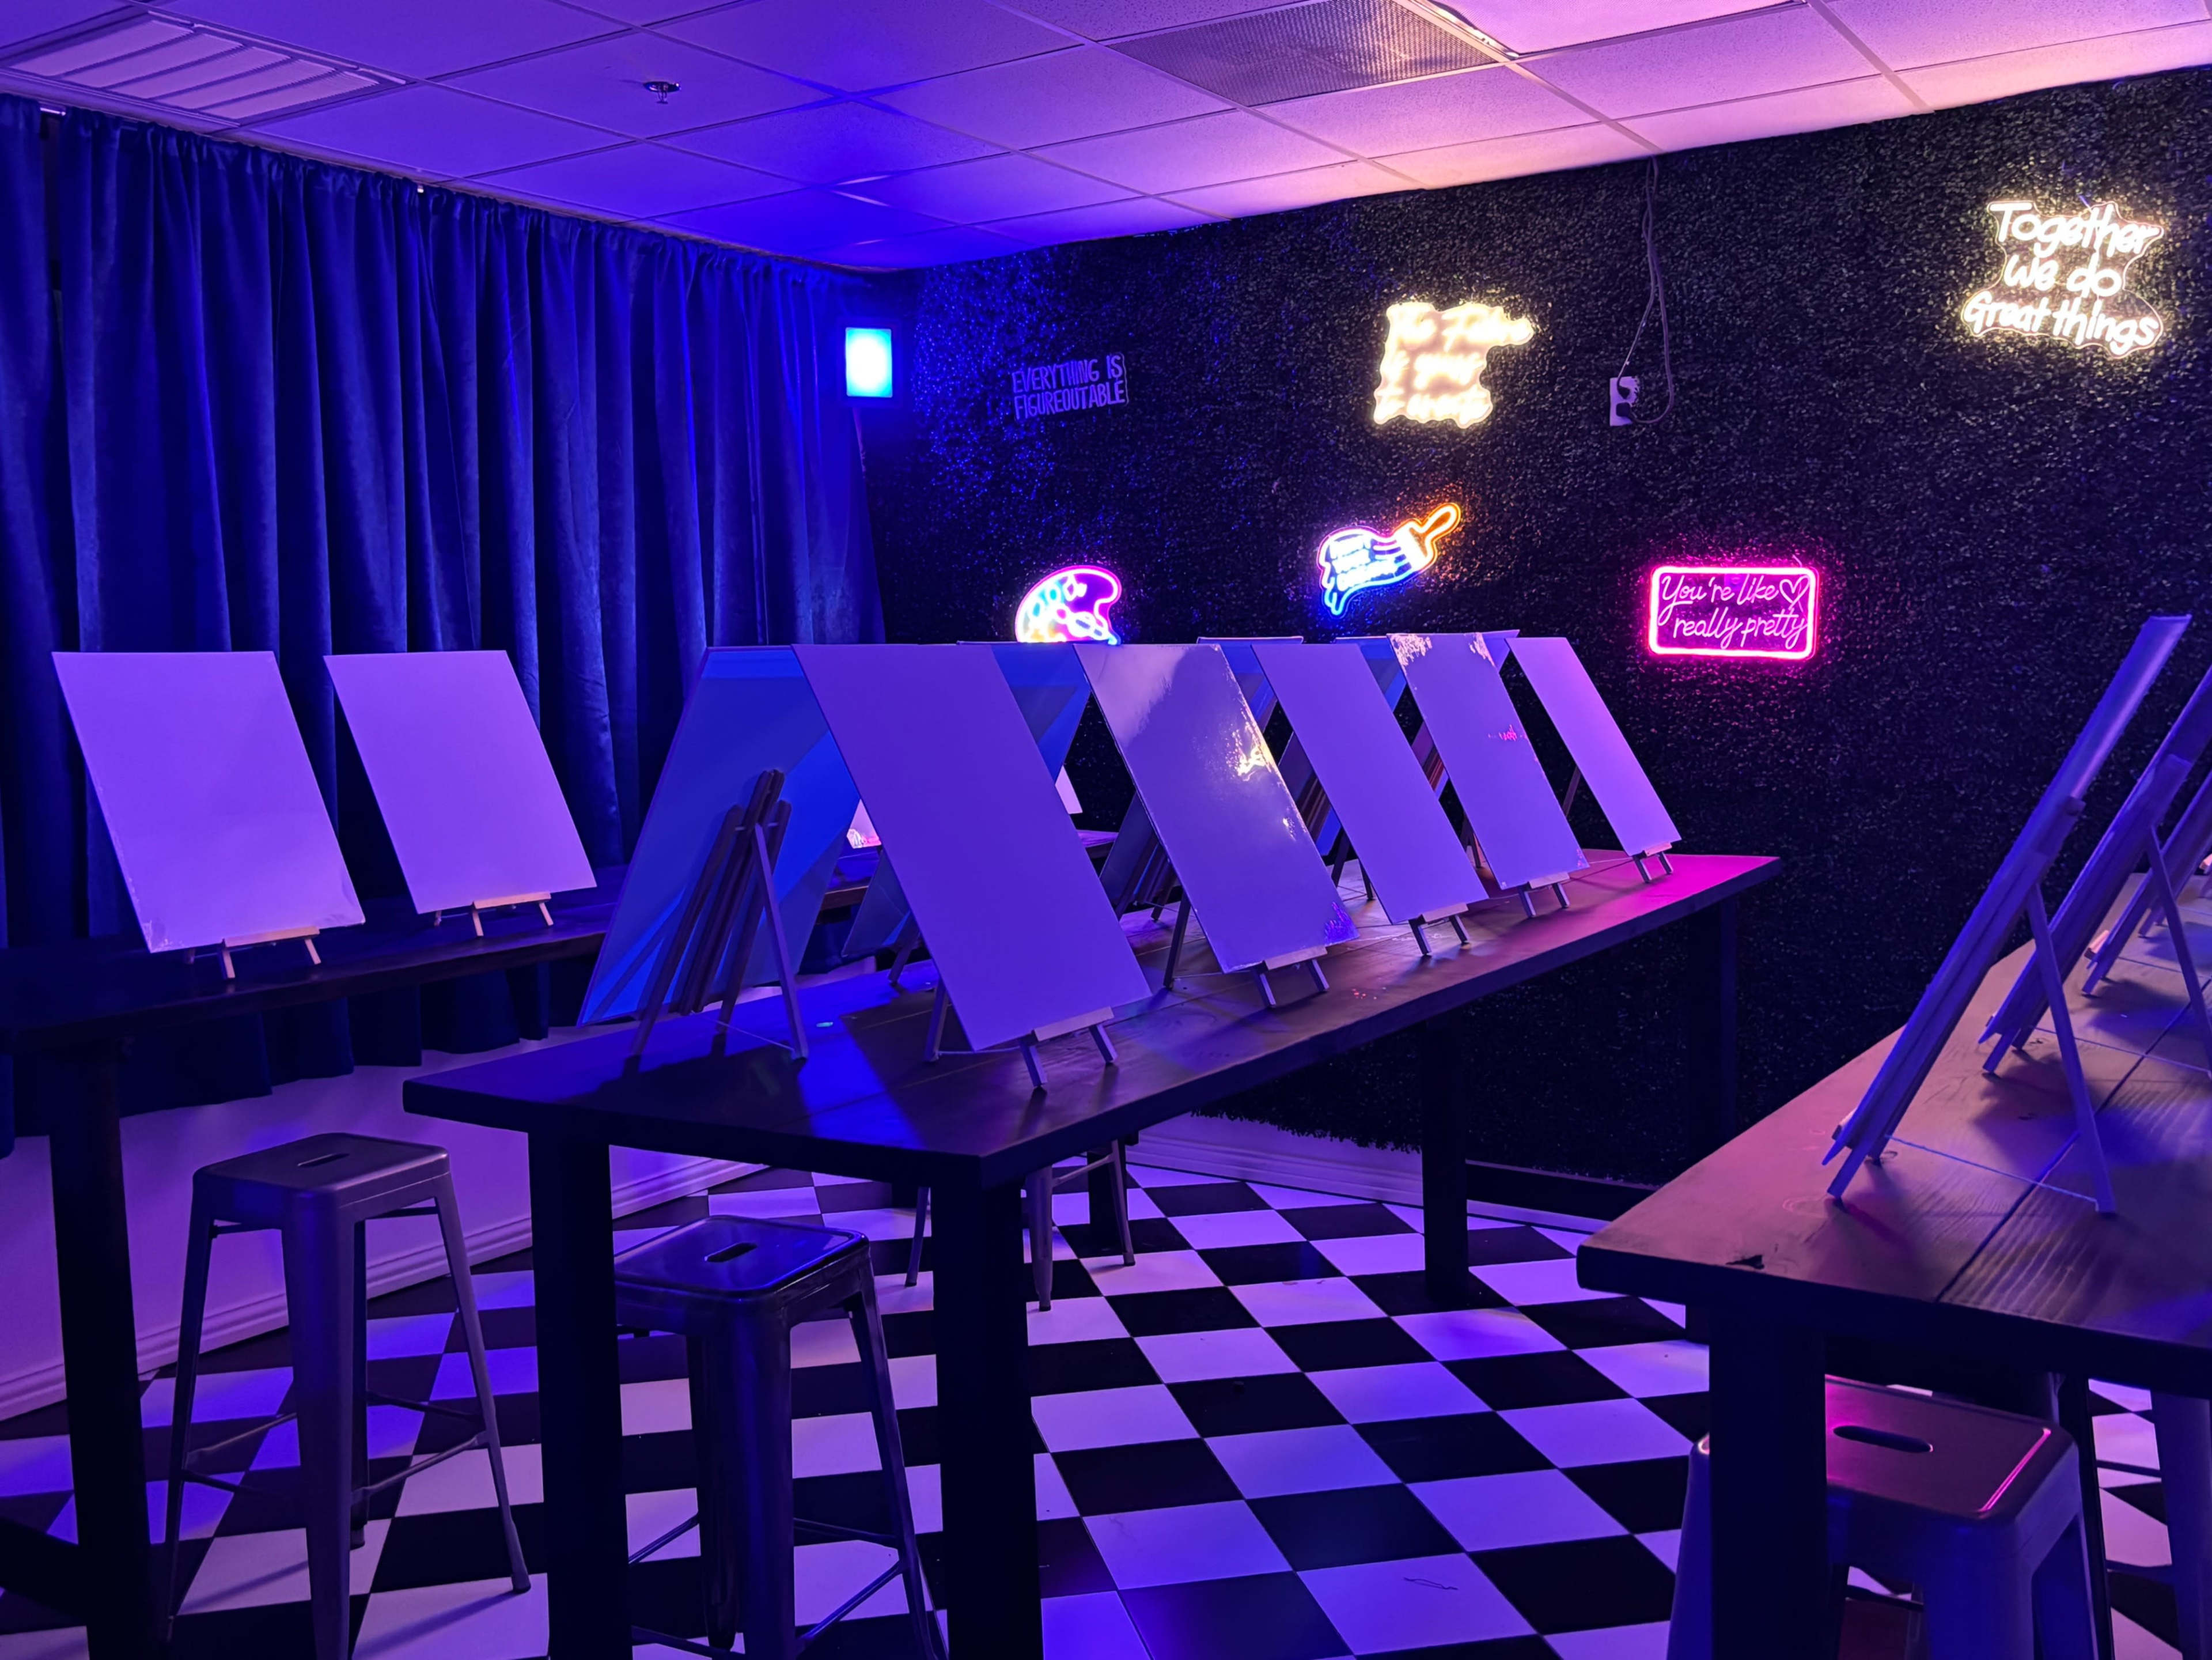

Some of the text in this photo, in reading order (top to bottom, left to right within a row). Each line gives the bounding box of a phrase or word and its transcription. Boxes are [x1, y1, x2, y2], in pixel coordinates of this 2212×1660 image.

[1989, 202, 2161, 258] Together
[2066, 252, 2122, 298] do
[2052, 297, 2160, 356] things
[1012, 355, 1123, 394] EVERYTHING IS
[1014, 380, 1125, 420] FIGUREOUTABLE
[1658, 573, 1779, 626] You're like
[1673, 606, 1808, 649] really pretty
